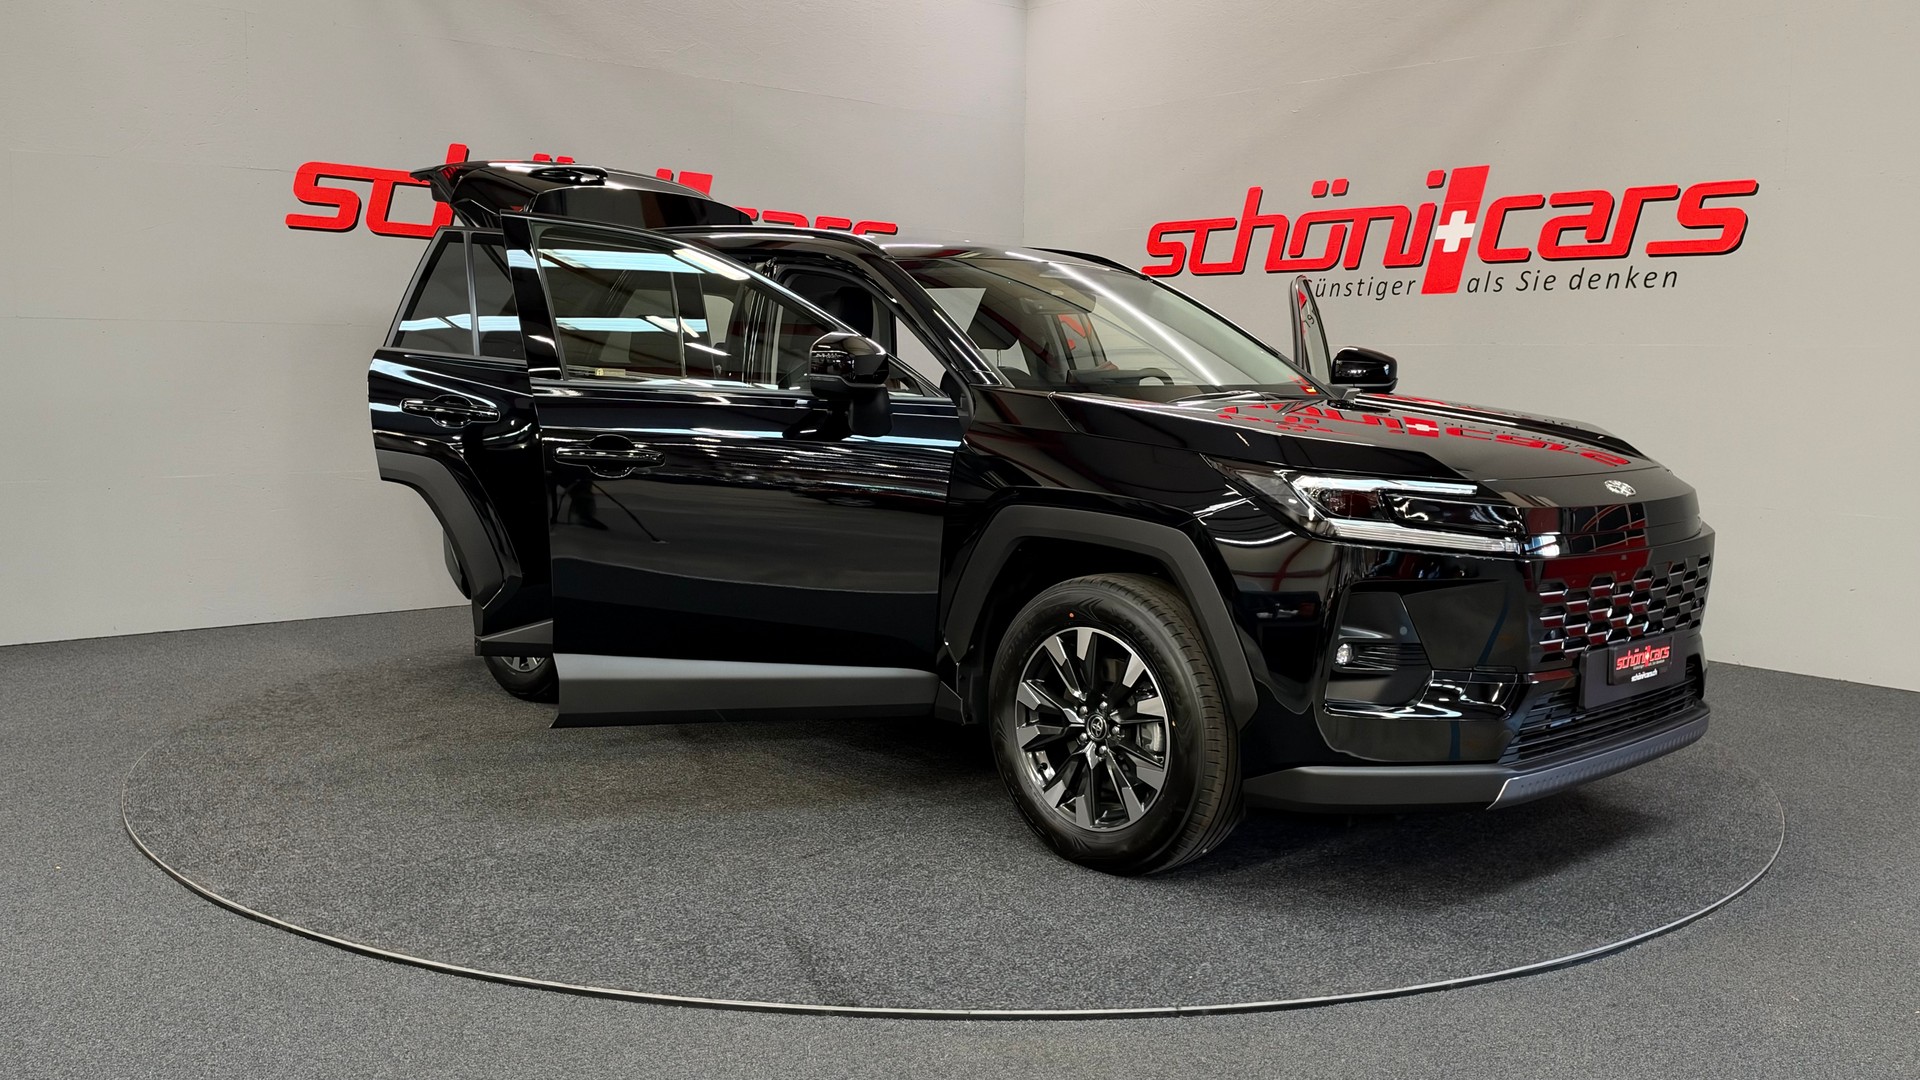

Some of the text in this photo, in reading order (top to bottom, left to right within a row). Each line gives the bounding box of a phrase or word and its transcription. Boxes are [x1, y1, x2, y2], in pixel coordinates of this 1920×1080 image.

[1306, 265, 1678, 301] ünstiger als Sie denken
